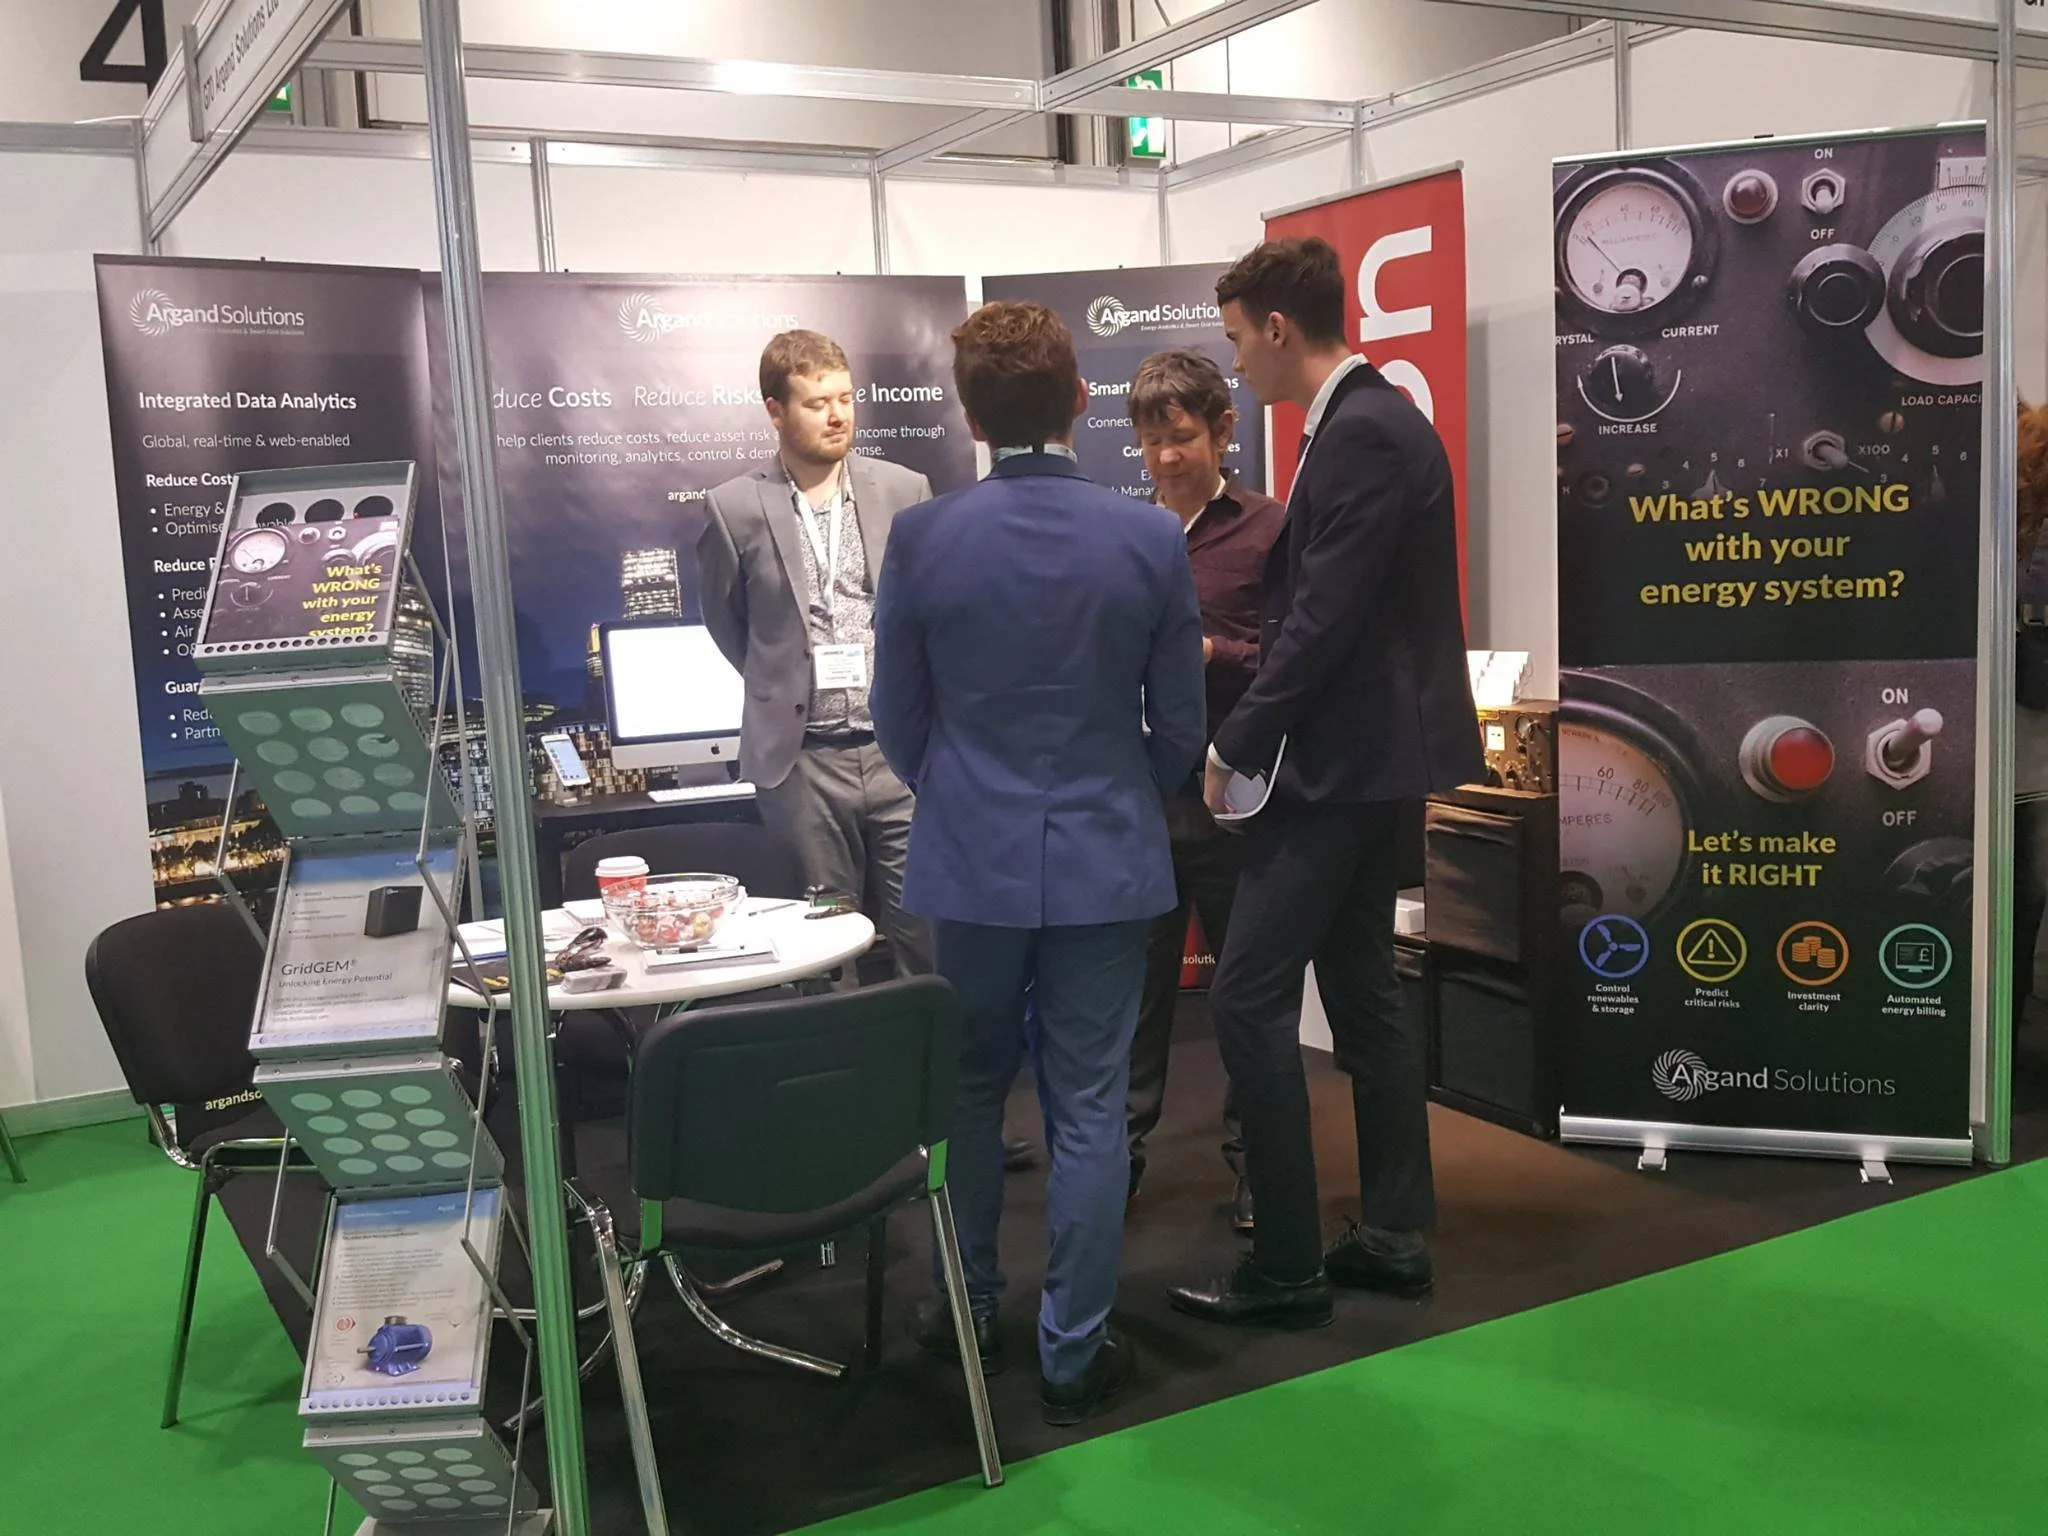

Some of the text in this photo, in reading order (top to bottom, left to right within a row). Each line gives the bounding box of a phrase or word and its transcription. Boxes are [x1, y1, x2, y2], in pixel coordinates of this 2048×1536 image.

[1814, 148, 1833, 159] ON
[1810, 228, 1835, 240] OFF
[221, 304, 305, 326] Solutions
[1100, 306, 1160, 327] Argand
[1661, 324, 1719, 338] CURRENT
[548, 386, 612, 408] Costs
[634, 386, 707, 406] Reduce
[871, 383, 943, 402] Income
[1088, 381, 1131, 396] Smart
[139, 391, 357, 412] Integrated Data Analytics
[1901, 395, 1934, 406] LOAD
[530, 433, 574, 446] clients
[577, 432, 623, 445] reduce
[667, 431, 710, 443] reduce
[714, 429, 745, 442] asset
[750, 428, 770, 441] risk
[855, 427, 897, 438] income
[901, 425, 945, 439] through
[1599, 423, 1657, 435] INCREASE
[143, 433, 350, 449] Global, real-time & web-enabled
[546, 452, 622, 466] monitoring,
[625, 450, 685, 464] analytics,
[688, 449, 732, 460] control
[736, 448, 746, 460] &
[146, 473, 198, 487] Reduce
[1757, 484, 1910, 517] WRONG
[164, 501, 225, 518] Energy &
[1685, 532, 1850, 564] with your
[154, 558, 206, 573] Reduce
[312, 578, 381, 594] WRONG
[1640, 569, 1905, 609] energy system?
[302, 595, 378, 610] with your
[320, 610, 376, 623] energy
[175, 625, 194, 638] Air
[1881, 688, 1909, 704] ON
[1597, 767, 1614, 779] 60
[1632, 778, 1650, 793] 80
[1882, 810, 1917, 826] OFF
[1759, 831, 1836, 853] make
[1702, 863, 1822, 886] it RIGHT
[1595, 984, 1630, 993] Control
[1695, 988, 1729, 997] Predict
[1787, 991, 1841, 1001] Investment
[1587, 995, 1639, 1004] renewables
[1684, 999, 1740, 1009] critical risks
[1886, 994, 1941, 1005] Automated
[1592, 1005, 1635, 1015] & storage
[1798, 1002, 1830, 1013] clarity
[1881, 1006, 1946, 1017] energy billing
[1671, 1063, 1896, 1096] Argand Solutions
